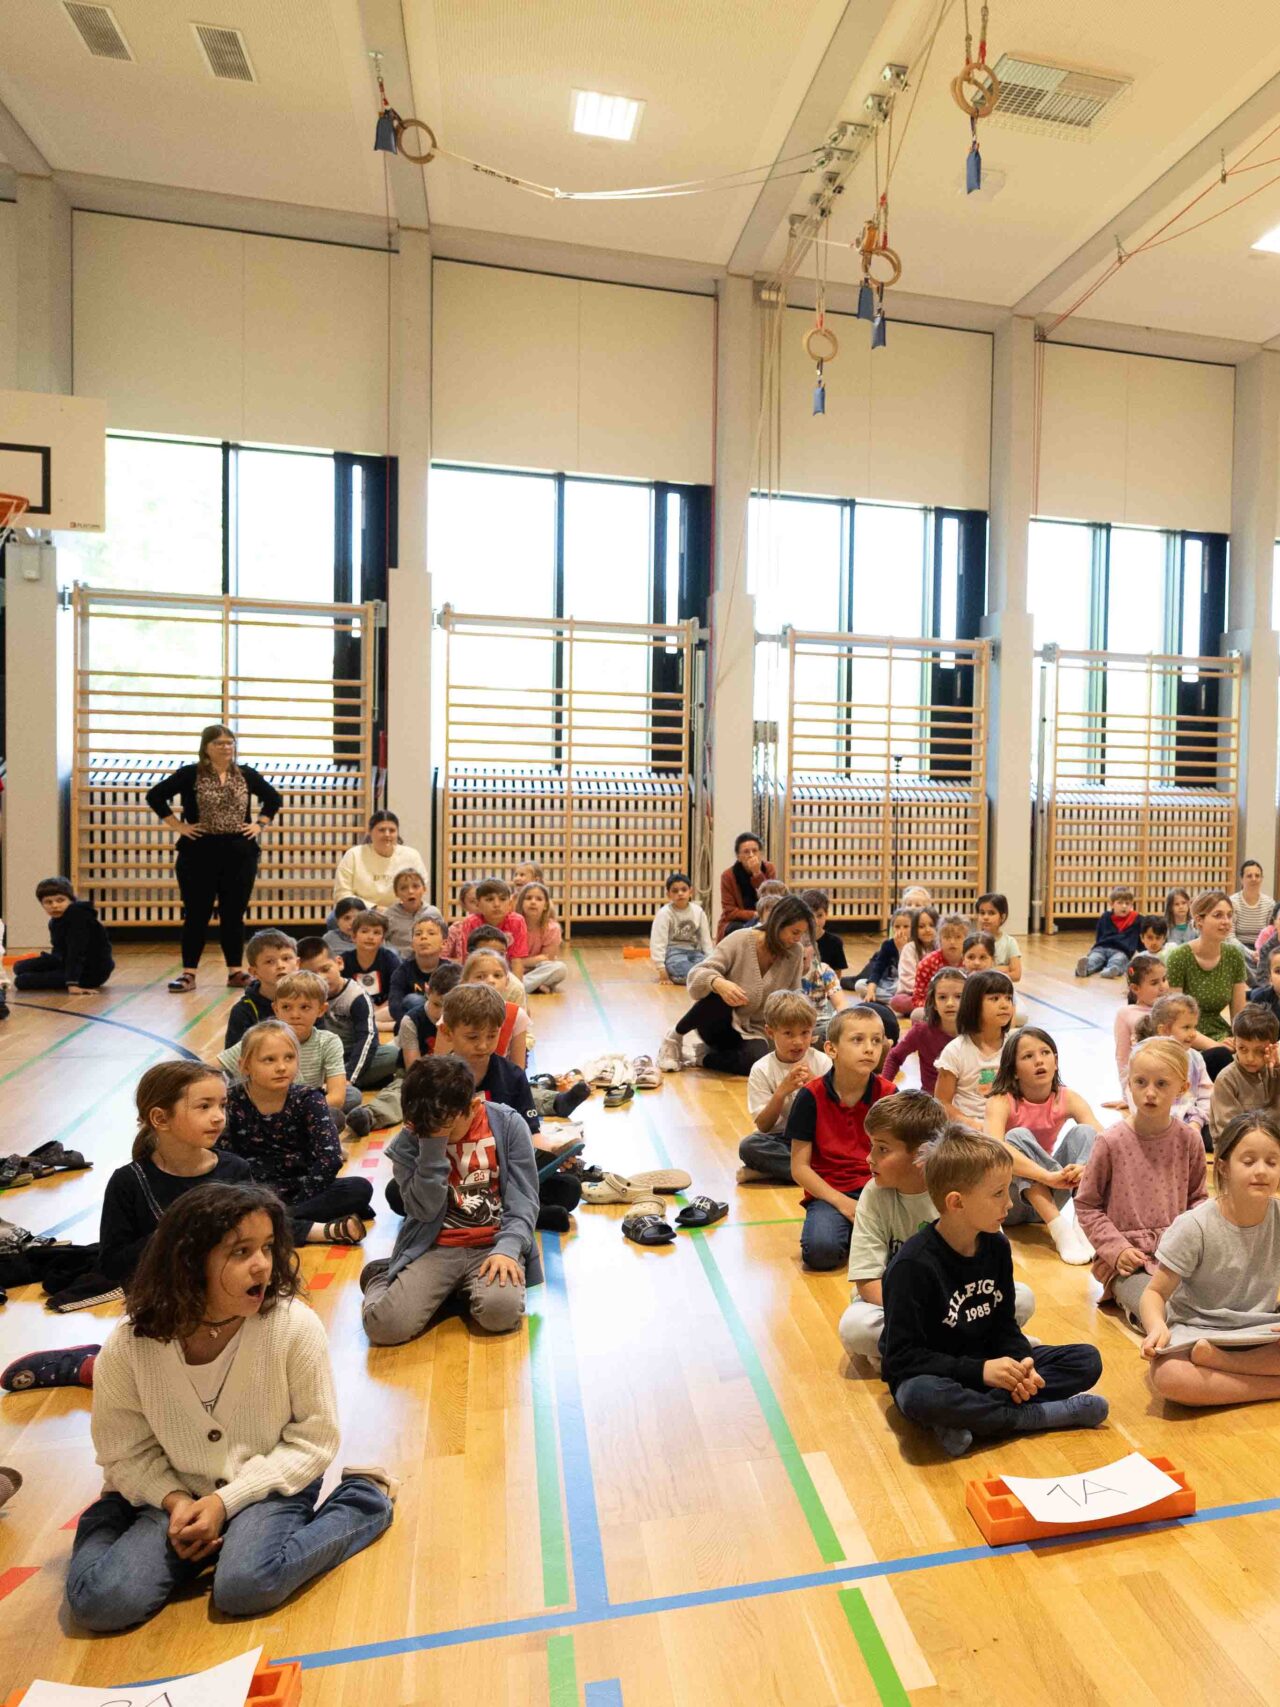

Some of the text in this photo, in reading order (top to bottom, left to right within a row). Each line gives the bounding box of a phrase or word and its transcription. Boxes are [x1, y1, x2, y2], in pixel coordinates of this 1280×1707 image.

[472, 163, 519, 185] SPIETH
[473, 1171, 486, 1182] 23
[942, 1278, 1004, 1329] HILFIGR
[965, 1302, 991, 1322] 1985
[1046, 1478, 1129, 1507] 1A
